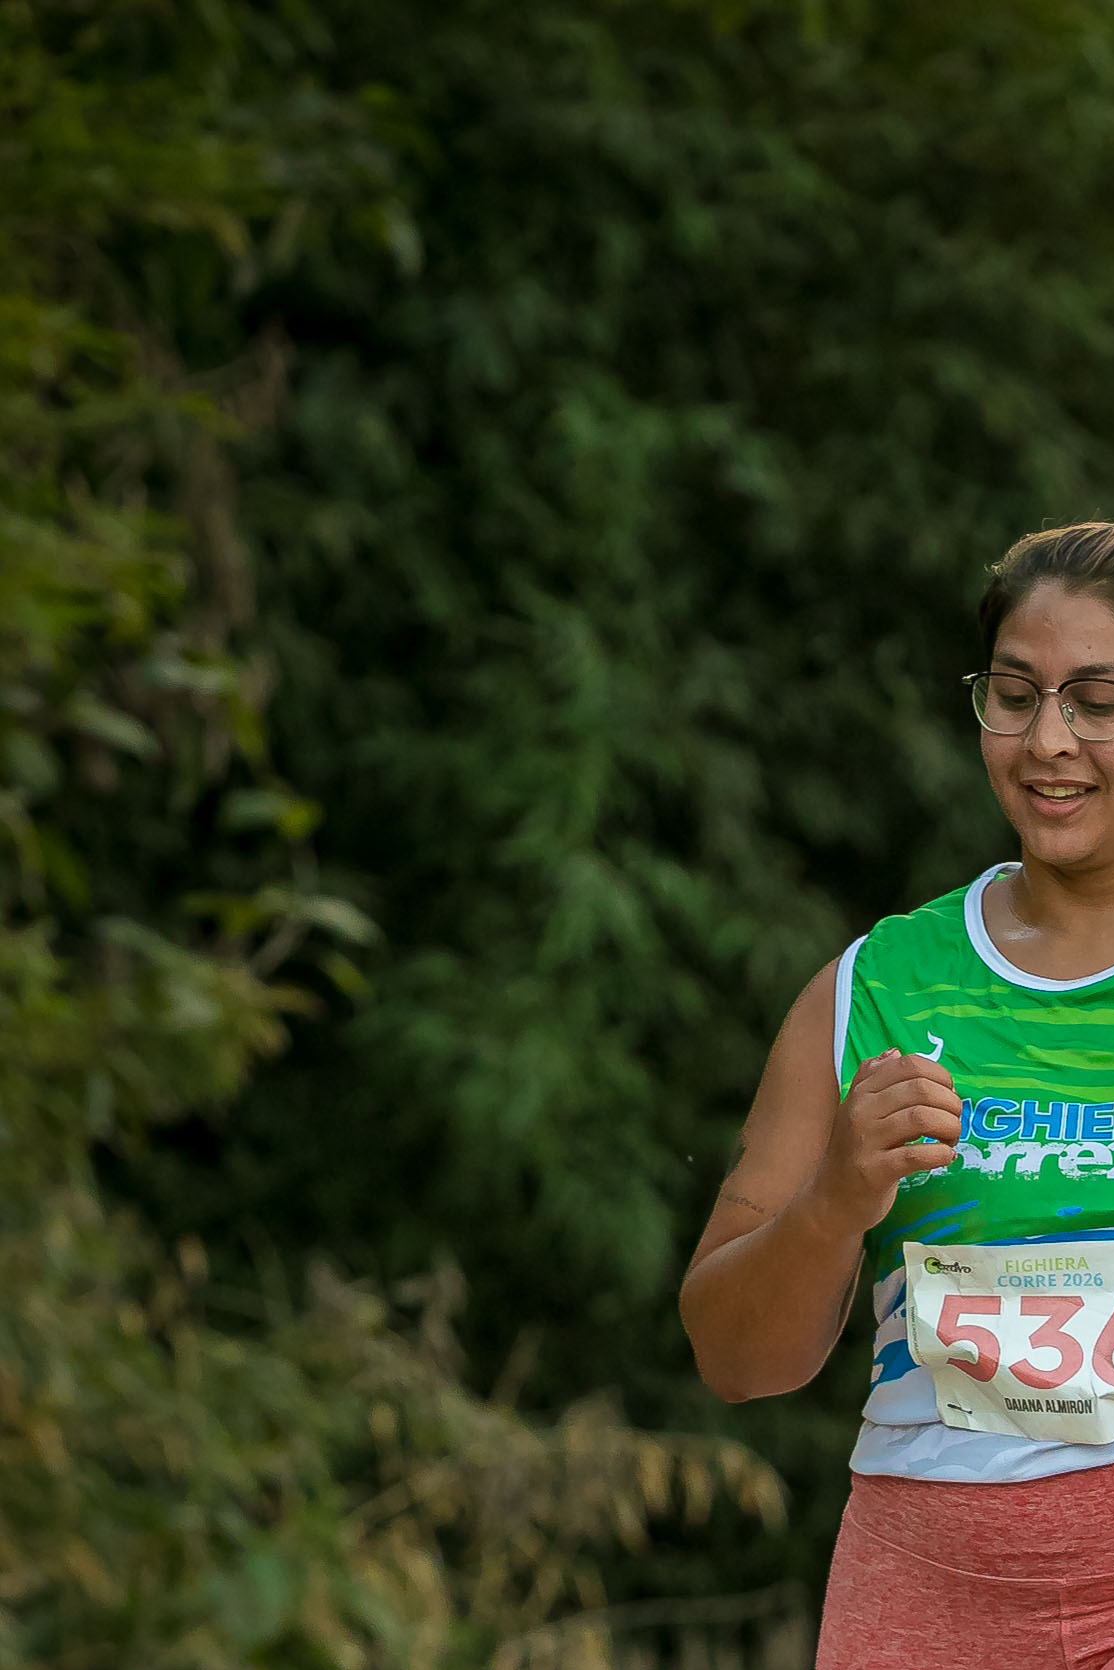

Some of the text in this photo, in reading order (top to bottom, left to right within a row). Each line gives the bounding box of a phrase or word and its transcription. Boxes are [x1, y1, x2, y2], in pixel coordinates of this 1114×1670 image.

[1005, 1256, 1089, 1273] FIGHIERA
[997, 1272, 1104, 1288] CORRE 2026
[1004, 1397, 1044, 1412] DAIANA
